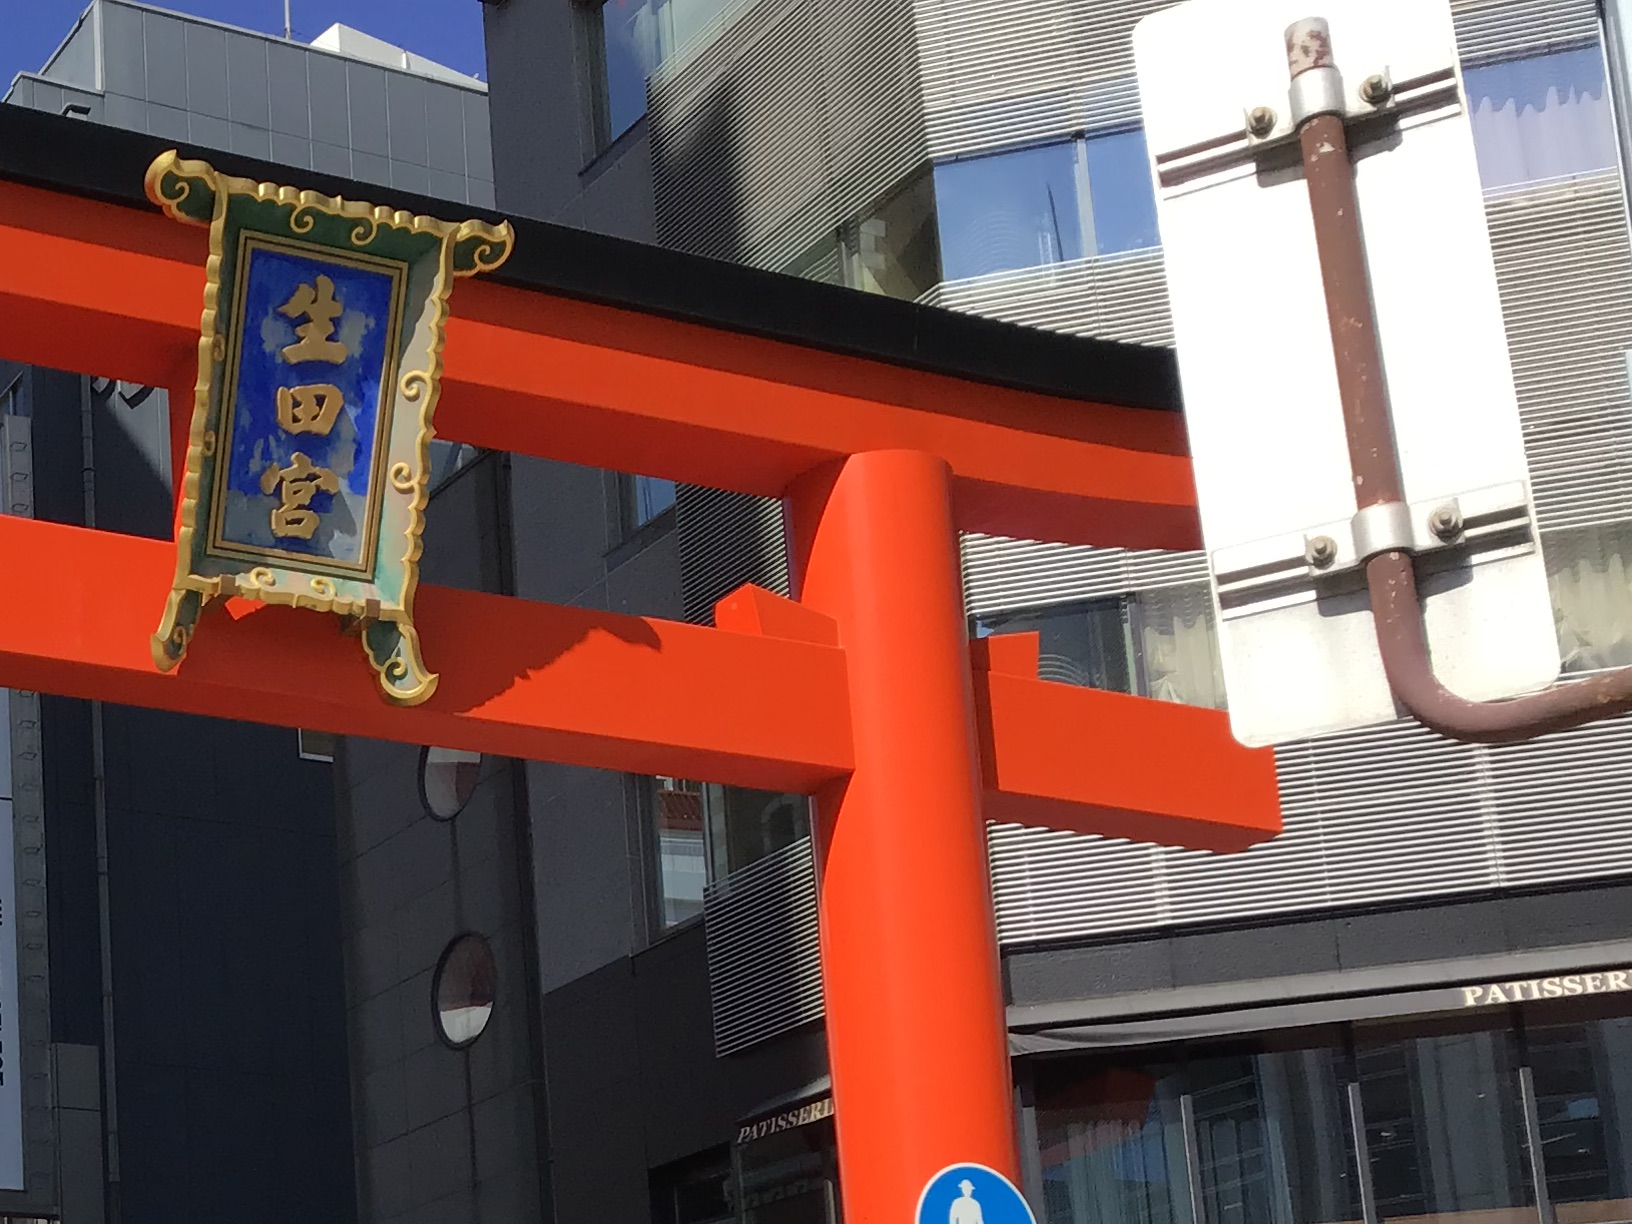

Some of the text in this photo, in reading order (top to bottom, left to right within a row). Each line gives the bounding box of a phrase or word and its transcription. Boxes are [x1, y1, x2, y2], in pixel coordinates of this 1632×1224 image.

[260, 274, 349, 541] 生田宮
[1461, 969, 1632, 1007] PATISSER
[736, 1097, 835, 1144] PATISSERI
